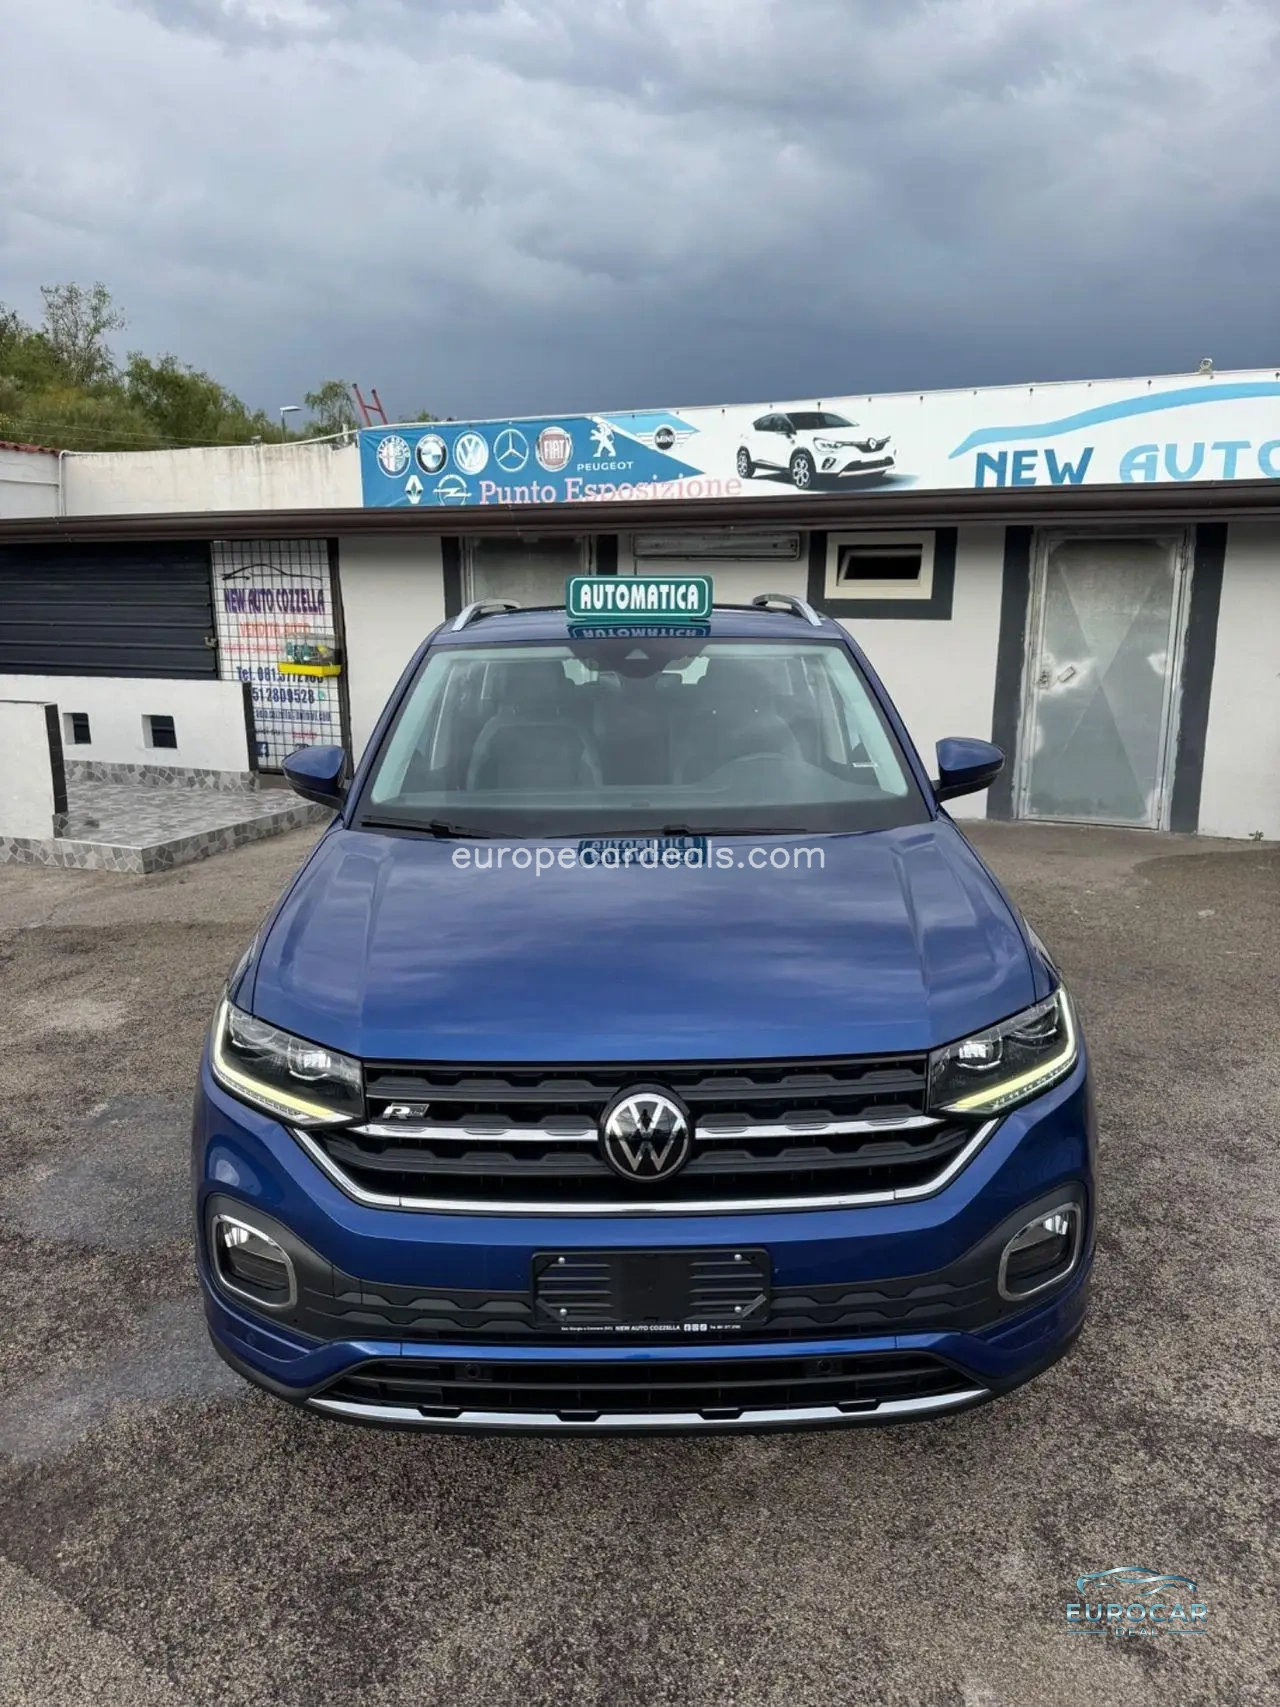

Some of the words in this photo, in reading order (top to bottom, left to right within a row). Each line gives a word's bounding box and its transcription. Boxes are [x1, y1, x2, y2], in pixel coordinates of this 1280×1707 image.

[543, 439, 566, 459] FIAT
[577, 461, 634, 472] PEUGEOT
[975, 447, 1095, 489] NEW
[479, 480, 556, 505] Punto
[564, 472, 742, 503] Esposizione
[223, 588, 245, 614] NEW
[248, 588, 275, 614] AUTO
[276, 588, 326, 615] COZZELLA
[580, 584, 699, 610] AUTOMATICA
